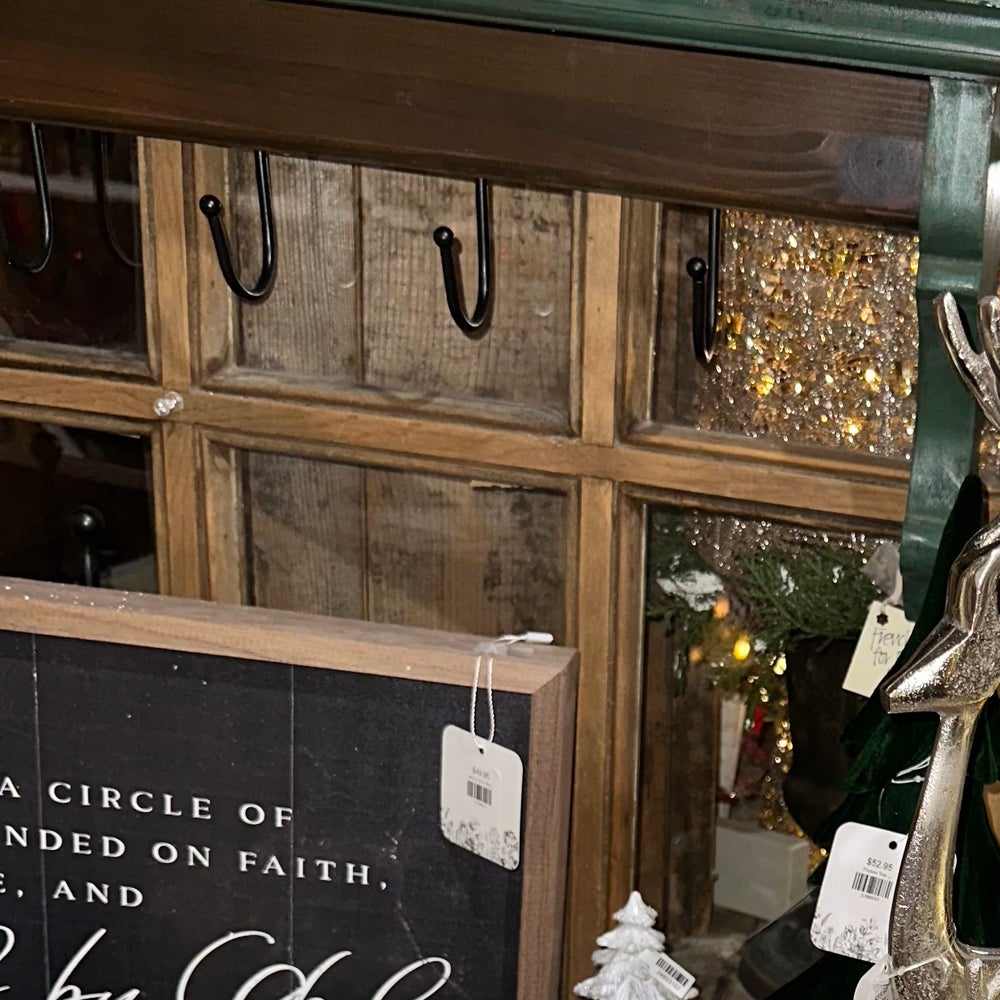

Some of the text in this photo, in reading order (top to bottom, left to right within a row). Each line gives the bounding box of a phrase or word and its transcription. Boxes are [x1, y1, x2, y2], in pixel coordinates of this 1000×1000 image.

[0, 776, 294, 828] A CIRCLE OF
[5, 825, 389, 890] NDED ON FAITH,
[866, 857, 893, 871] $52.95
[53, 880, 143, 907] AND
